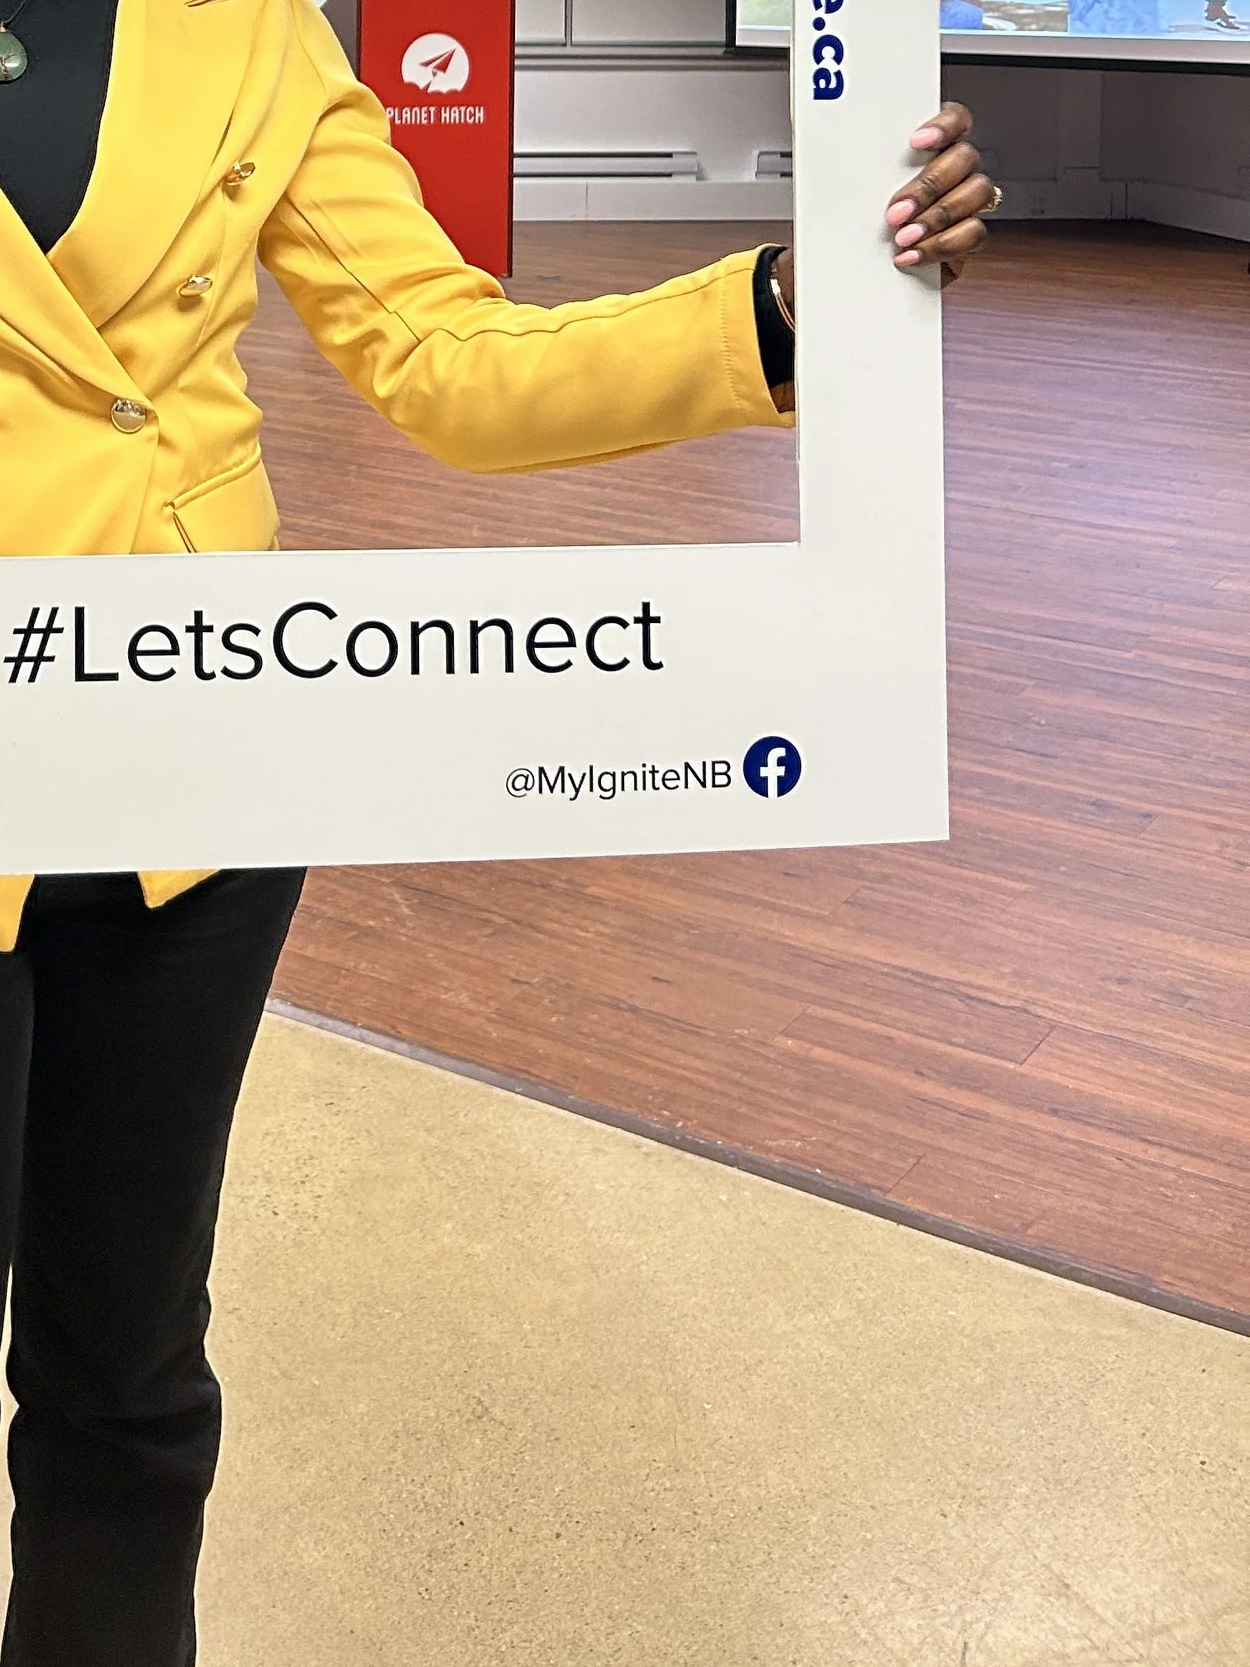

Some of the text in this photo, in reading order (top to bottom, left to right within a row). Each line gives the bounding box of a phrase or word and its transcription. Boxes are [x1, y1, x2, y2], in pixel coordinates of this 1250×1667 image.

[386, 105, 484, 125] PLANET HATCH
[3, 601, 664, 684] #LetsConnect
[505, 758, 733, 801] @MyIgniteNB
